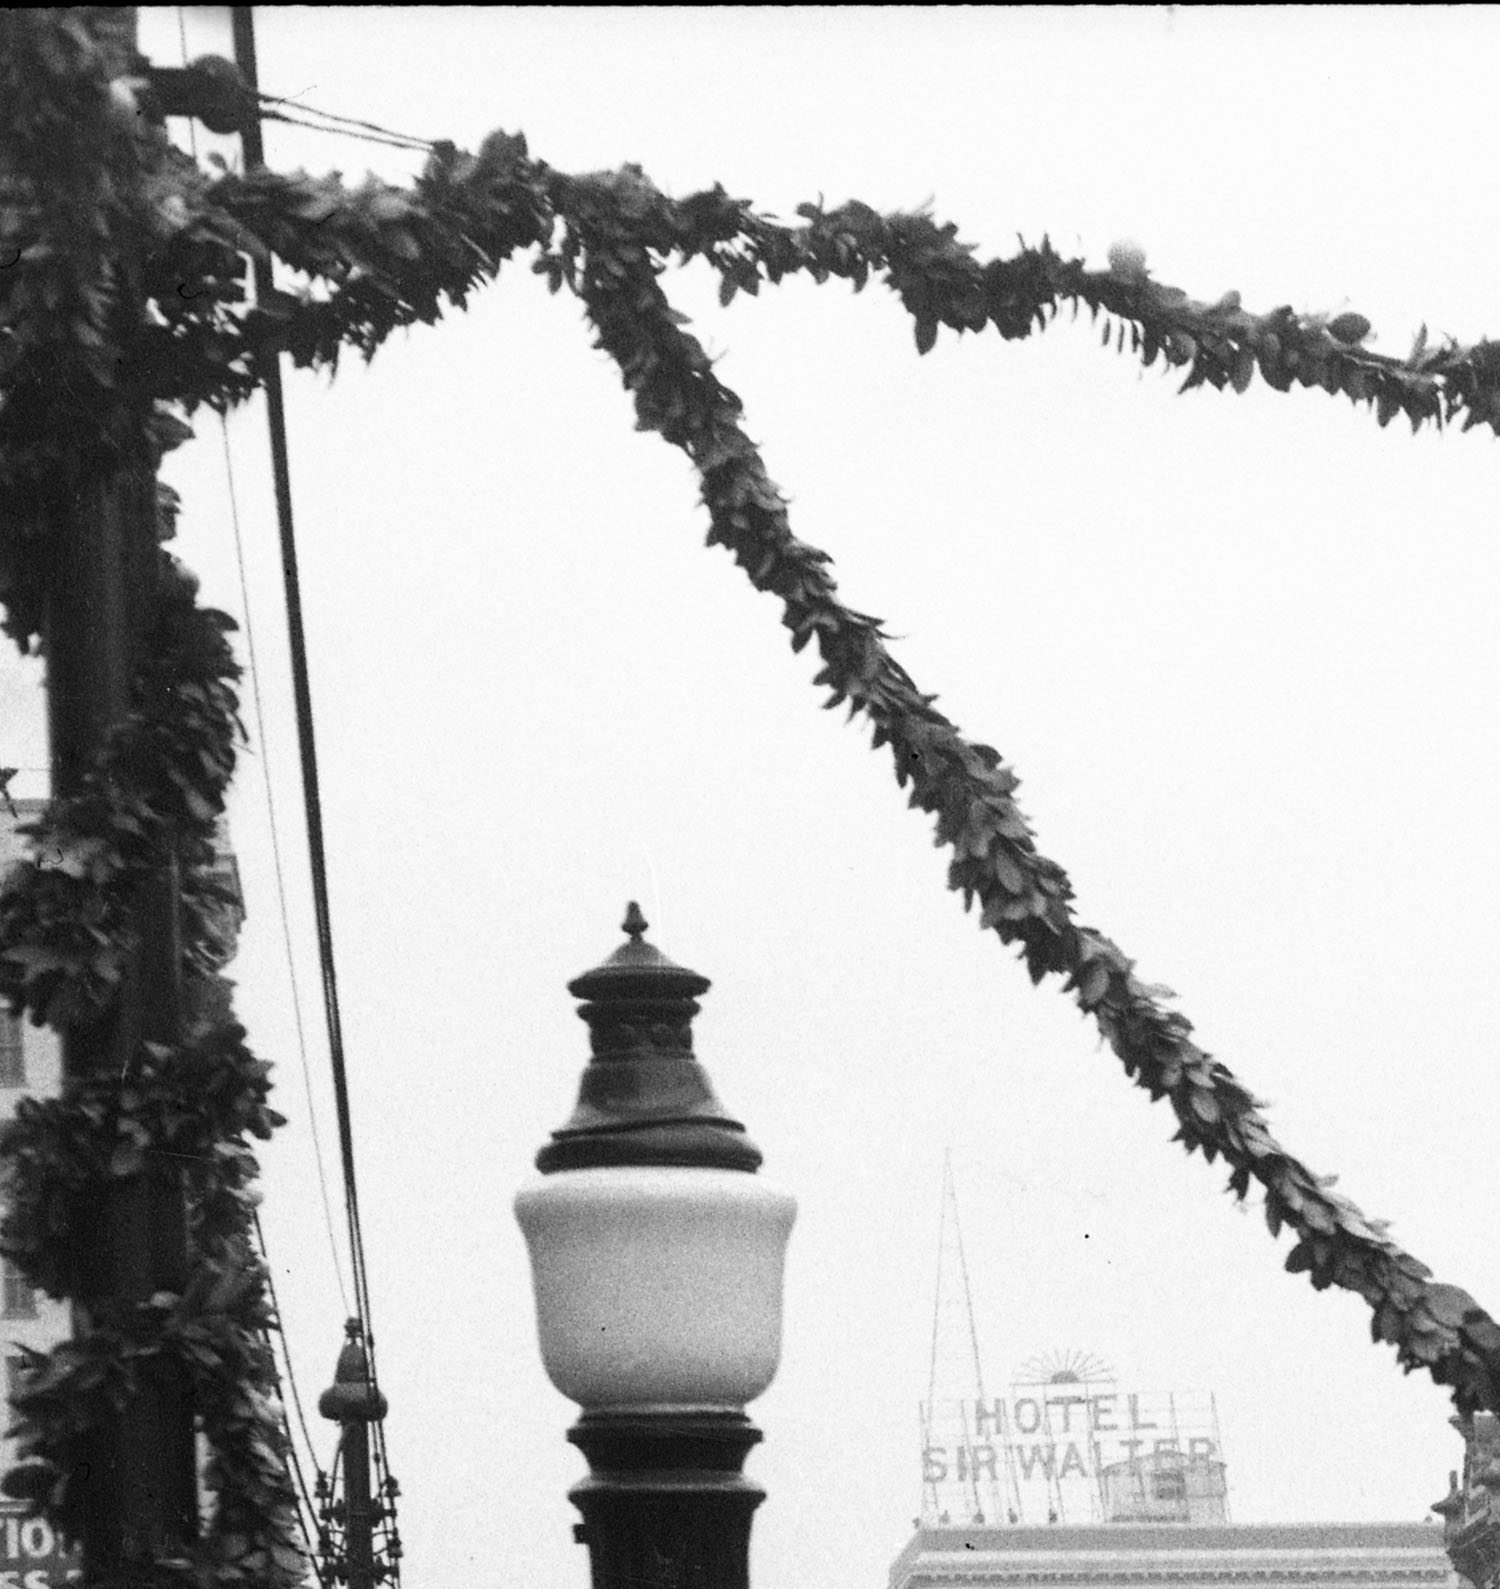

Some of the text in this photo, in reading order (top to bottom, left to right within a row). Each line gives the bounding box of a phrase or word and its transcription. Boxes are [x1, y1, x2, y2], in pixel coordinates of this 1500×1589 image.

[973, 1394, 1158, 1437] HOTEL
[922, 1436, 1219, 1484] SIR WALTER
